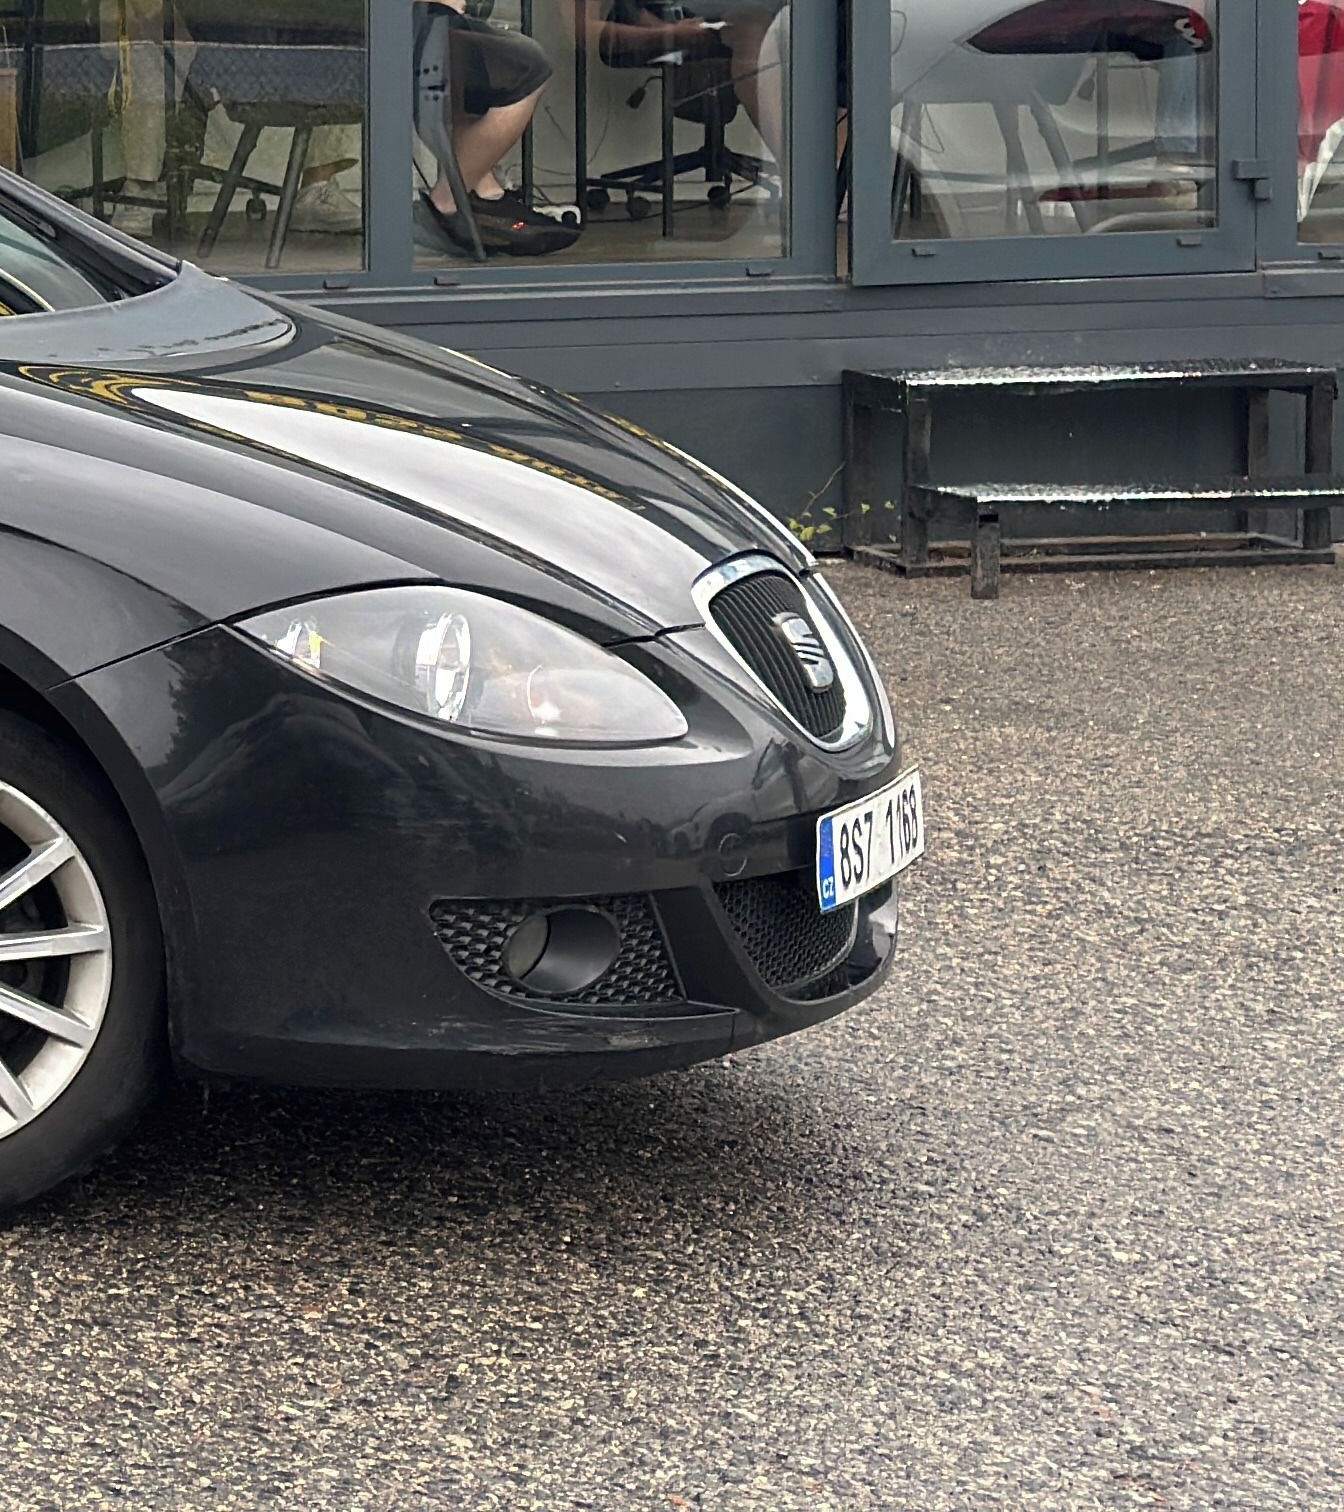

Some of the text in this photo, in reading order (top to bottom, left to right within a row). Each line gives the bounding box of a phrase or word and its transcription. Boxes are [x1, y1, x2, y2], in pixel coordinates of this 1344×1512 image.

[839, 784, 918, 890] 8S7 1168
[822, 875, 834, 899] CZ
